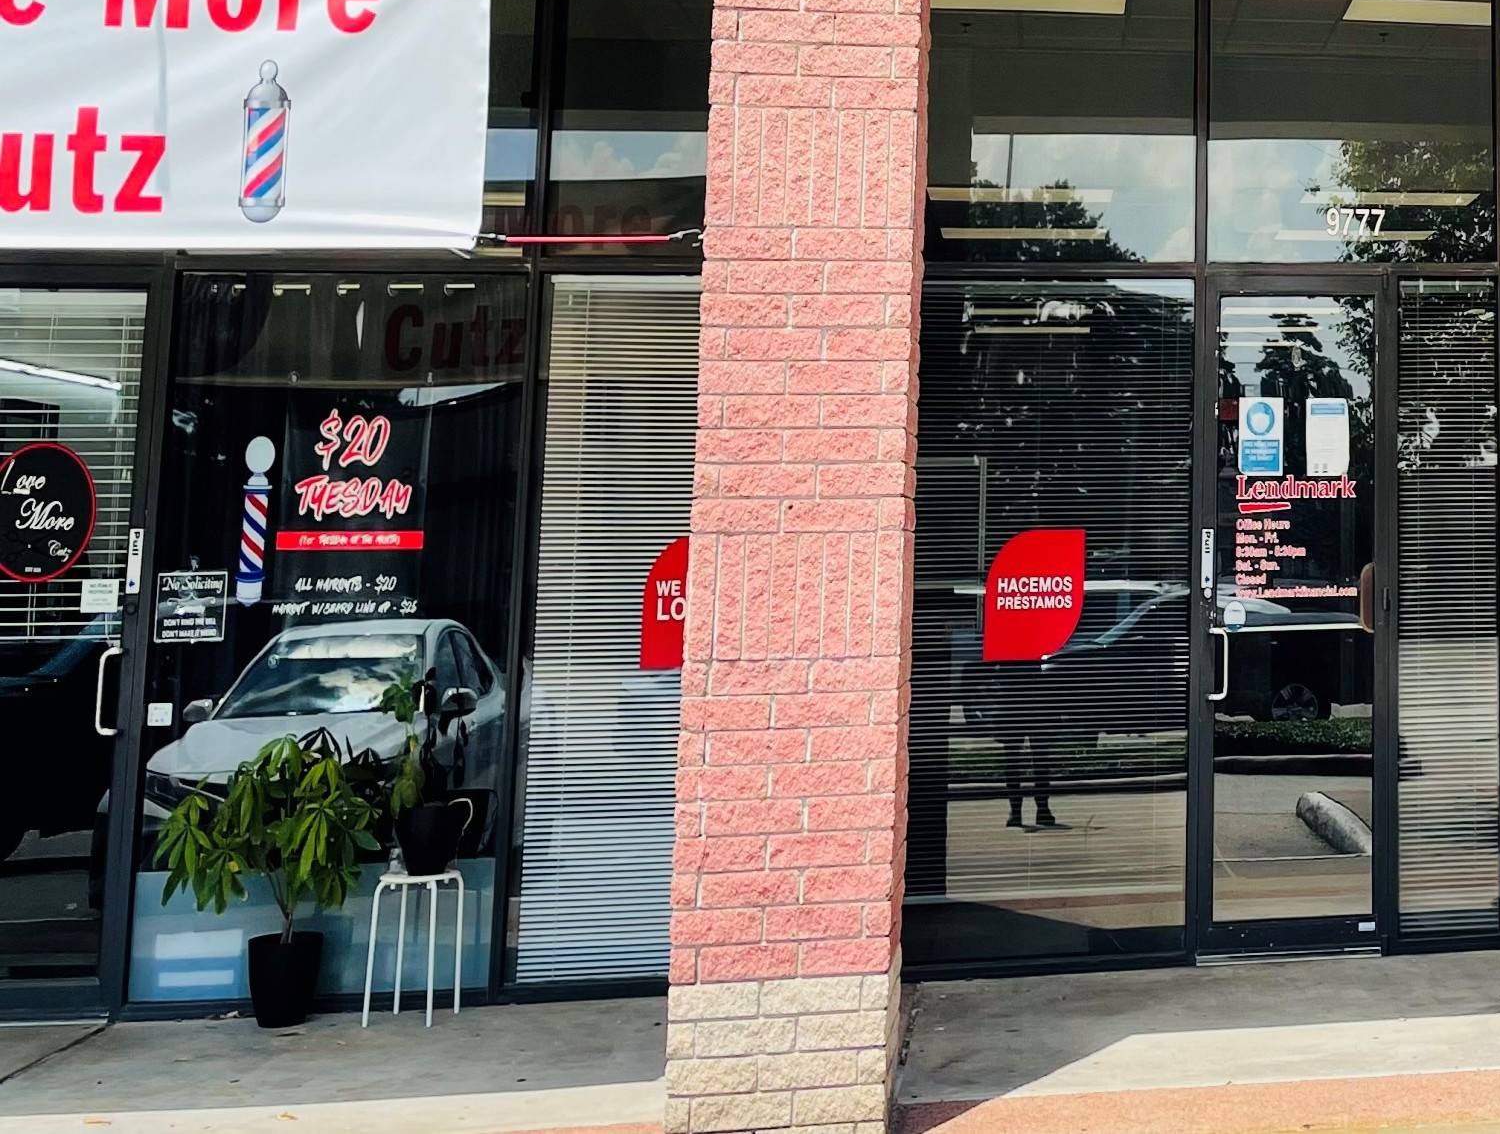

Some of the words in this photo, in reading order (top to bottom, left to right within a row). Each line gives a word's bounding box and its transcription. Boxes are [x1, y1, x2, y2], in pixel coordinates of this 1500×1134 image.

[1326, 207, 1386, 237] 9777
[314, 408, 390, 471] $20
[295, 474, 412, 521] TUESDAY
[1235, 474, 1356, 500] Lendmark
[15, 498, 75, 531] More
[1264, 518, 1290, 530] Hours
[132, 531, 140, 556] Pull
[162, 577, 180, 591] No
[181, 576, 223, 594] Soliciting
[295, 577, 313, 592] ALL
[374, 573, 397, 594] $20
[656, 580, 681, 596] WE
[997, 576, 1072, 593] HACEMOS
[997, 593, 1072, 610] PRÉSTAMOS
